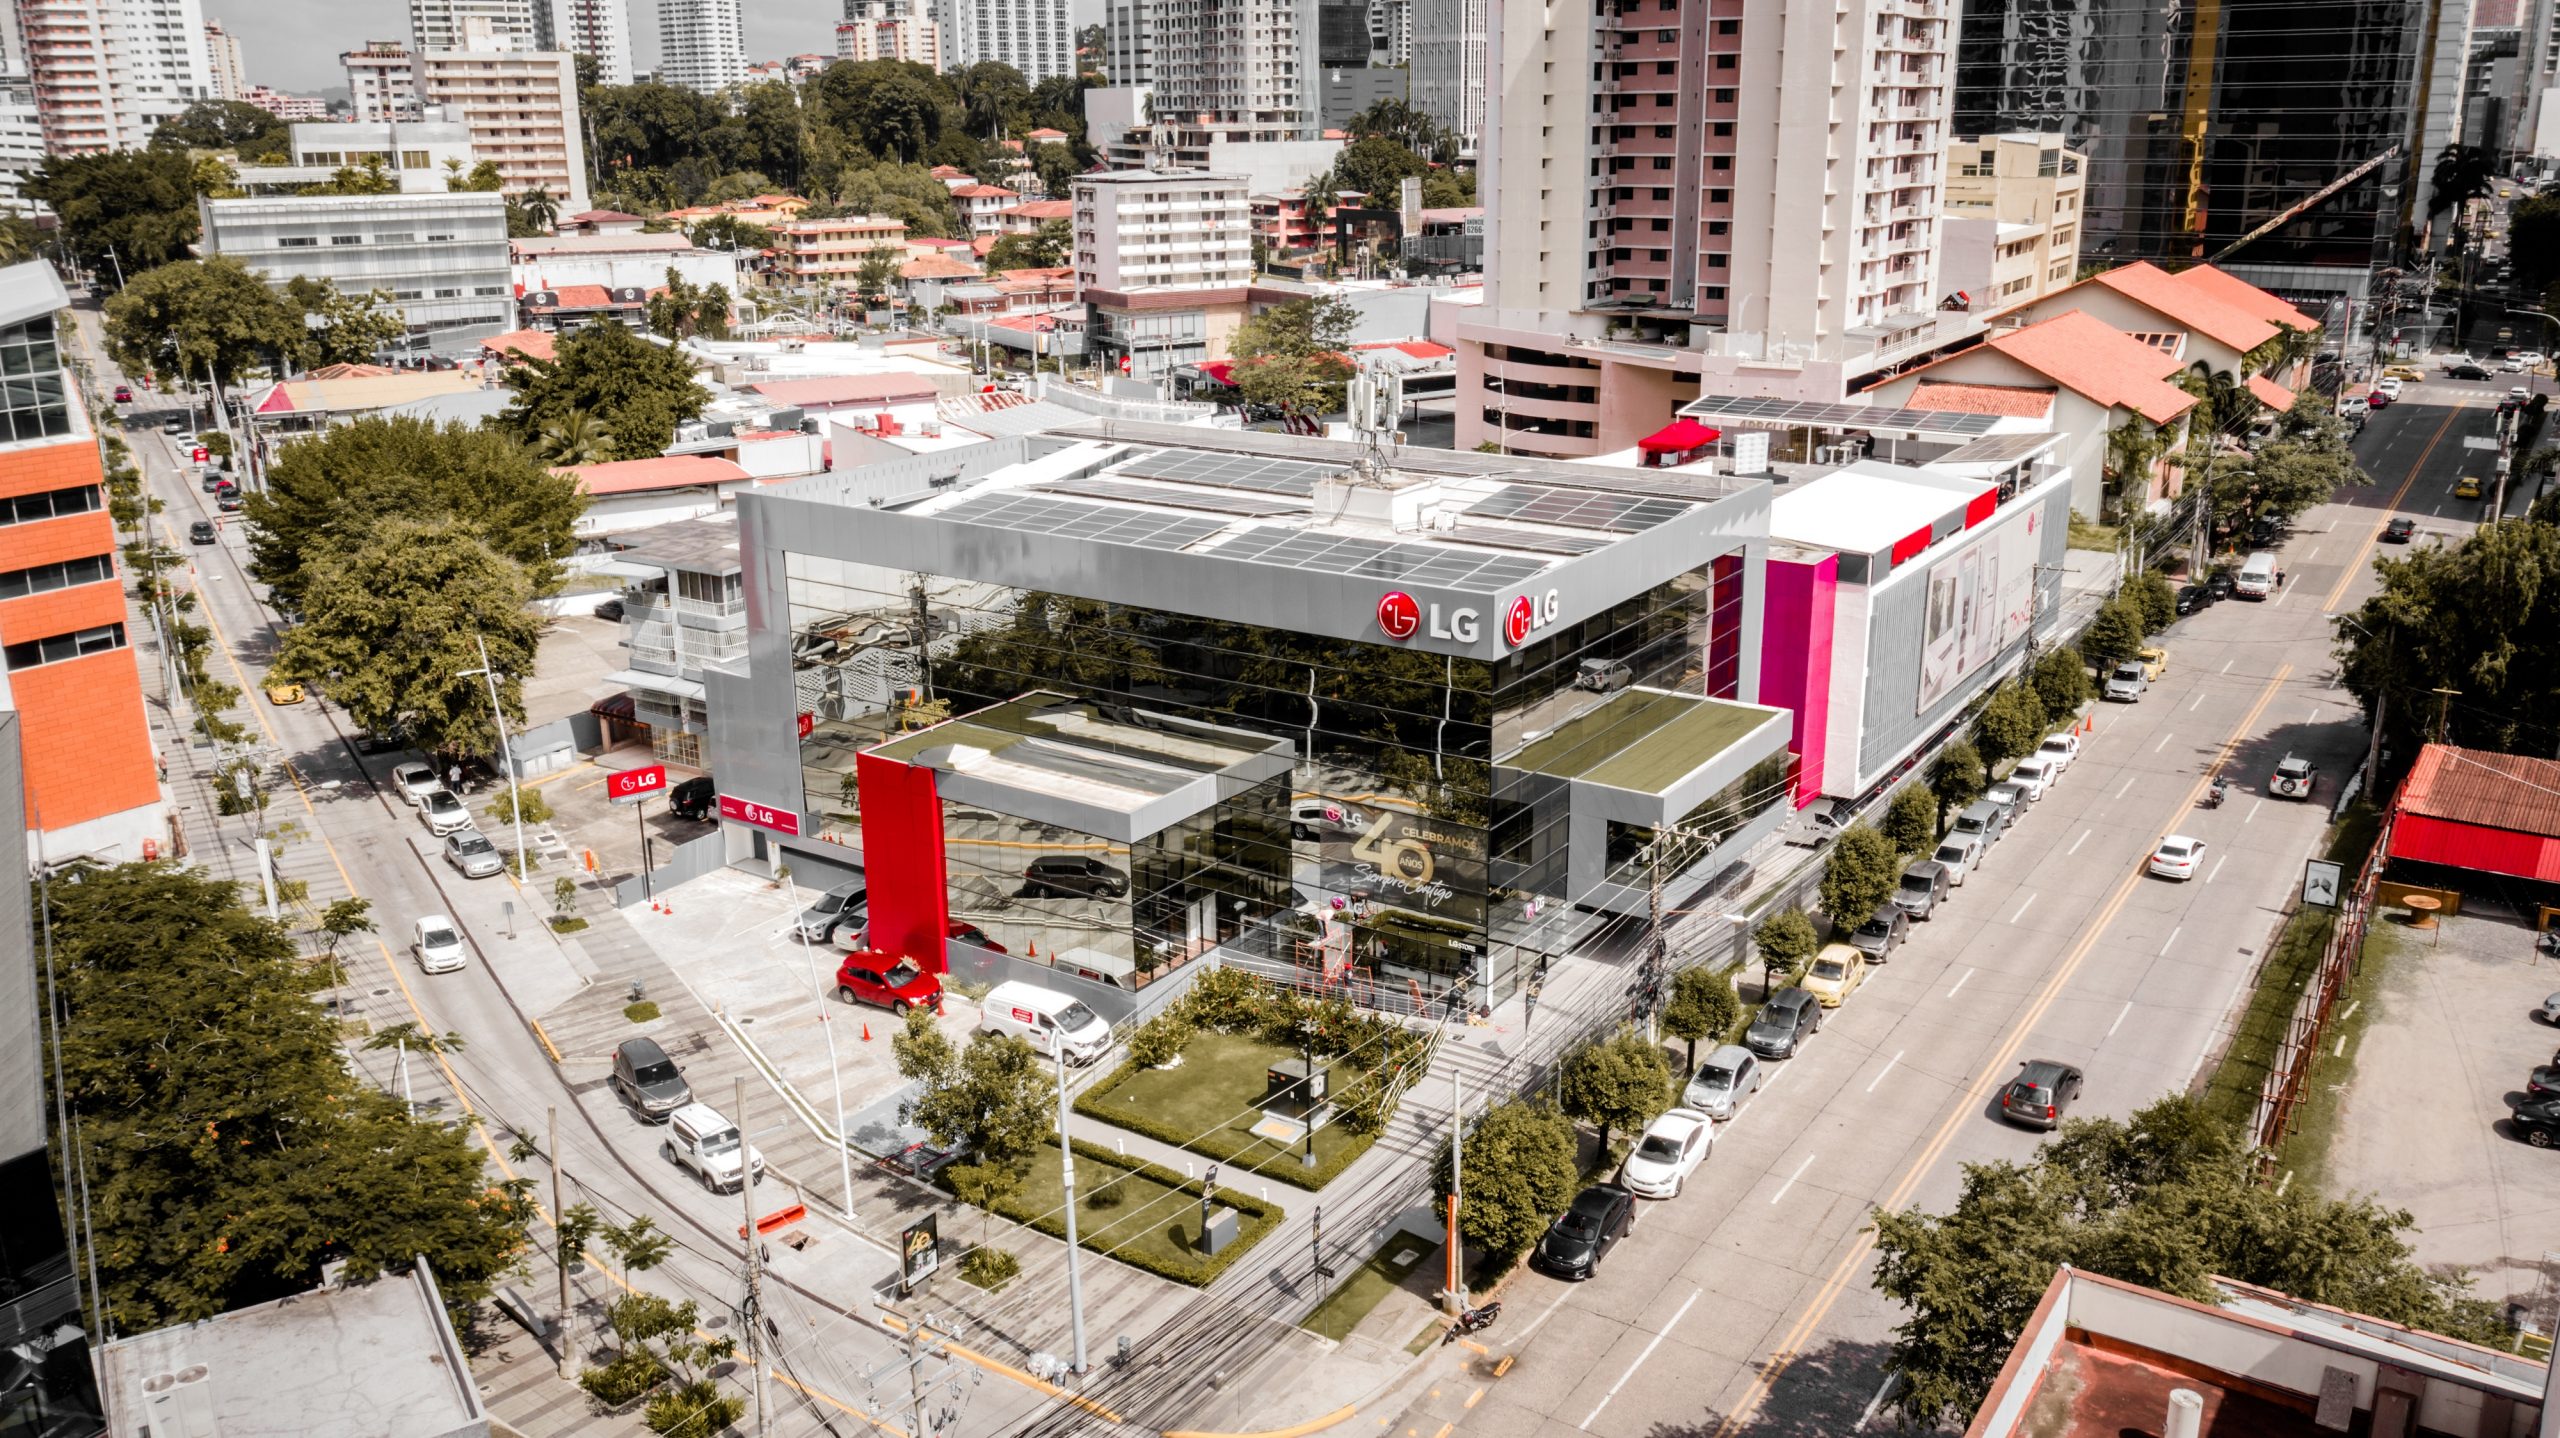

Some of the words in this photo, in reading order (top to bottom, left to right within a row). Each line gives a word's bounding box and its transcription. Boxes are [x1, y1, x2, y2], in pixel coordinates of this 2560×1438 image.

[1532, 588, 1559, 629] LG
[1430, 603, 1479, 643] LG
[637, 773, 656, 787] LG
[759, 809, 774, 824] LG
[1343, 810, 1362, 826] LG
[1402, 826, 1478, 851] CELEBRAMOS
[1351, 811, 1434, 887] 40
[1399, 856, 1424, 870] AÑOS
[1351, 864, 1405, 893] Siempre
[1404, 877, 1453, 907] Contigo
[1448, 939, 1458, 948] LG
[1458, 942, 1476, 953] STORE
